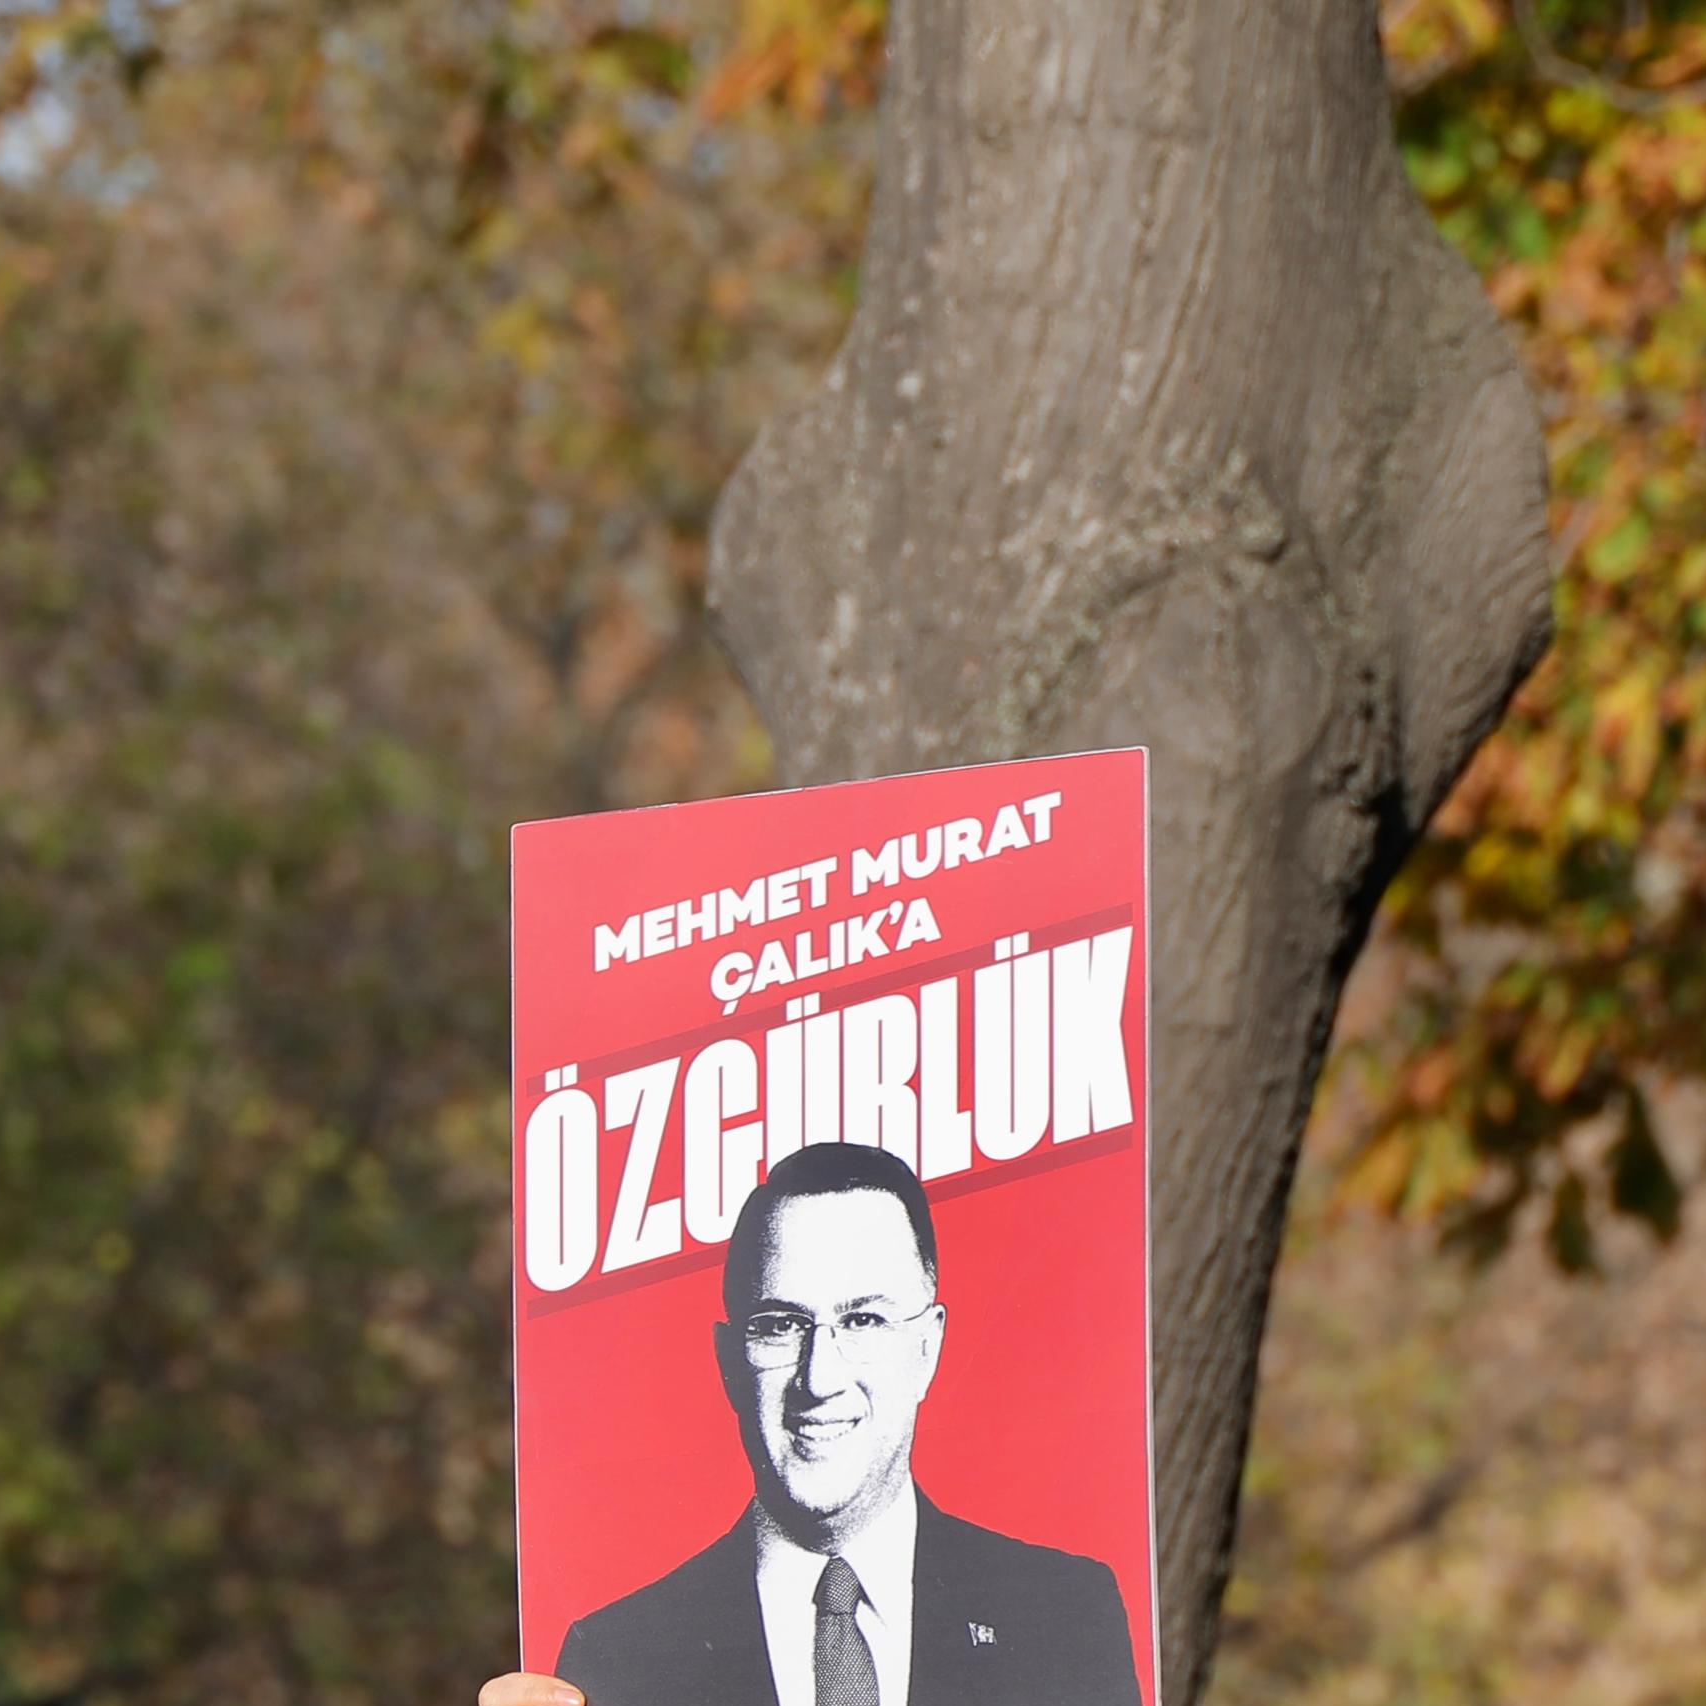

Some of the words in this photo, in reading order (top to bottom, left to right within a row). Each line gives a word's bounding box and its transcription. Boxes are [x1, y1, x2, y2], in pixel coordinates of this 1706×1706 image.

[594, 856, 838, 973] MEHMET
[851, 791, 1062, 897] MURAT
[525, 924, 1134, 1293] ÖZGÜRLÜK
